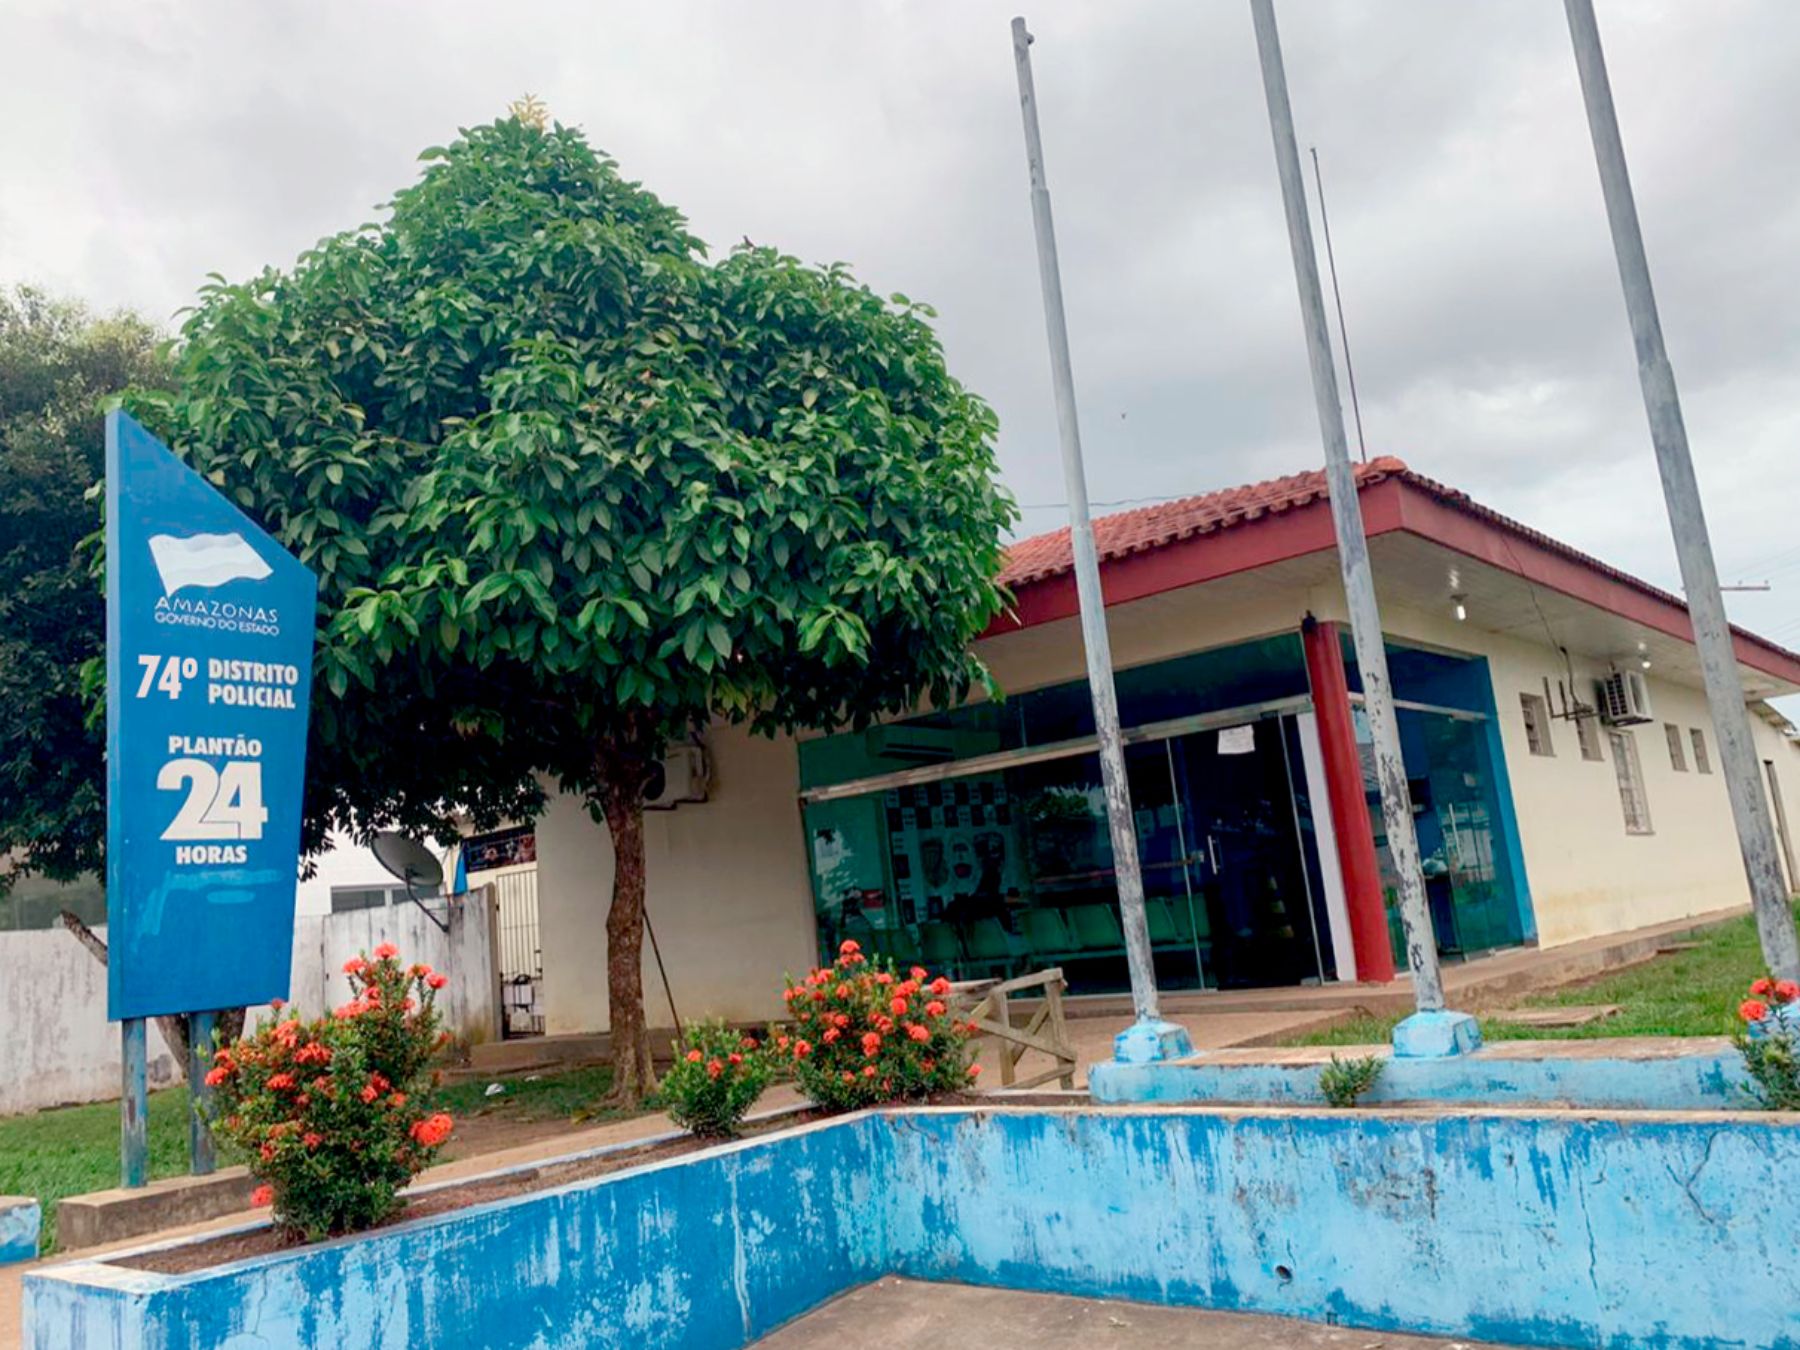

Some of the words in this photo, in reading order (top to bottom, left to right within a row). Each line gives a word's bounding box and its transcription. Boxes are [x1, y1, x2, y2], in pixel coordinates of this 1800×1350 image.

[155, 596, 278, 623] AMAZONAS
[154, 612, 217, 628] GOVERNO
[218, 619, 237, 631] DO
[238, 620, 280, 636] ESTADO
[208, 658, 299, 684] DISTRITO
[208, 683, 296, 709] POLICIAL
[168, 735, 262, 757] PLANTÃO
[156, 758, 268, 840] 24
[176, 846, 247, 865] HORAS
